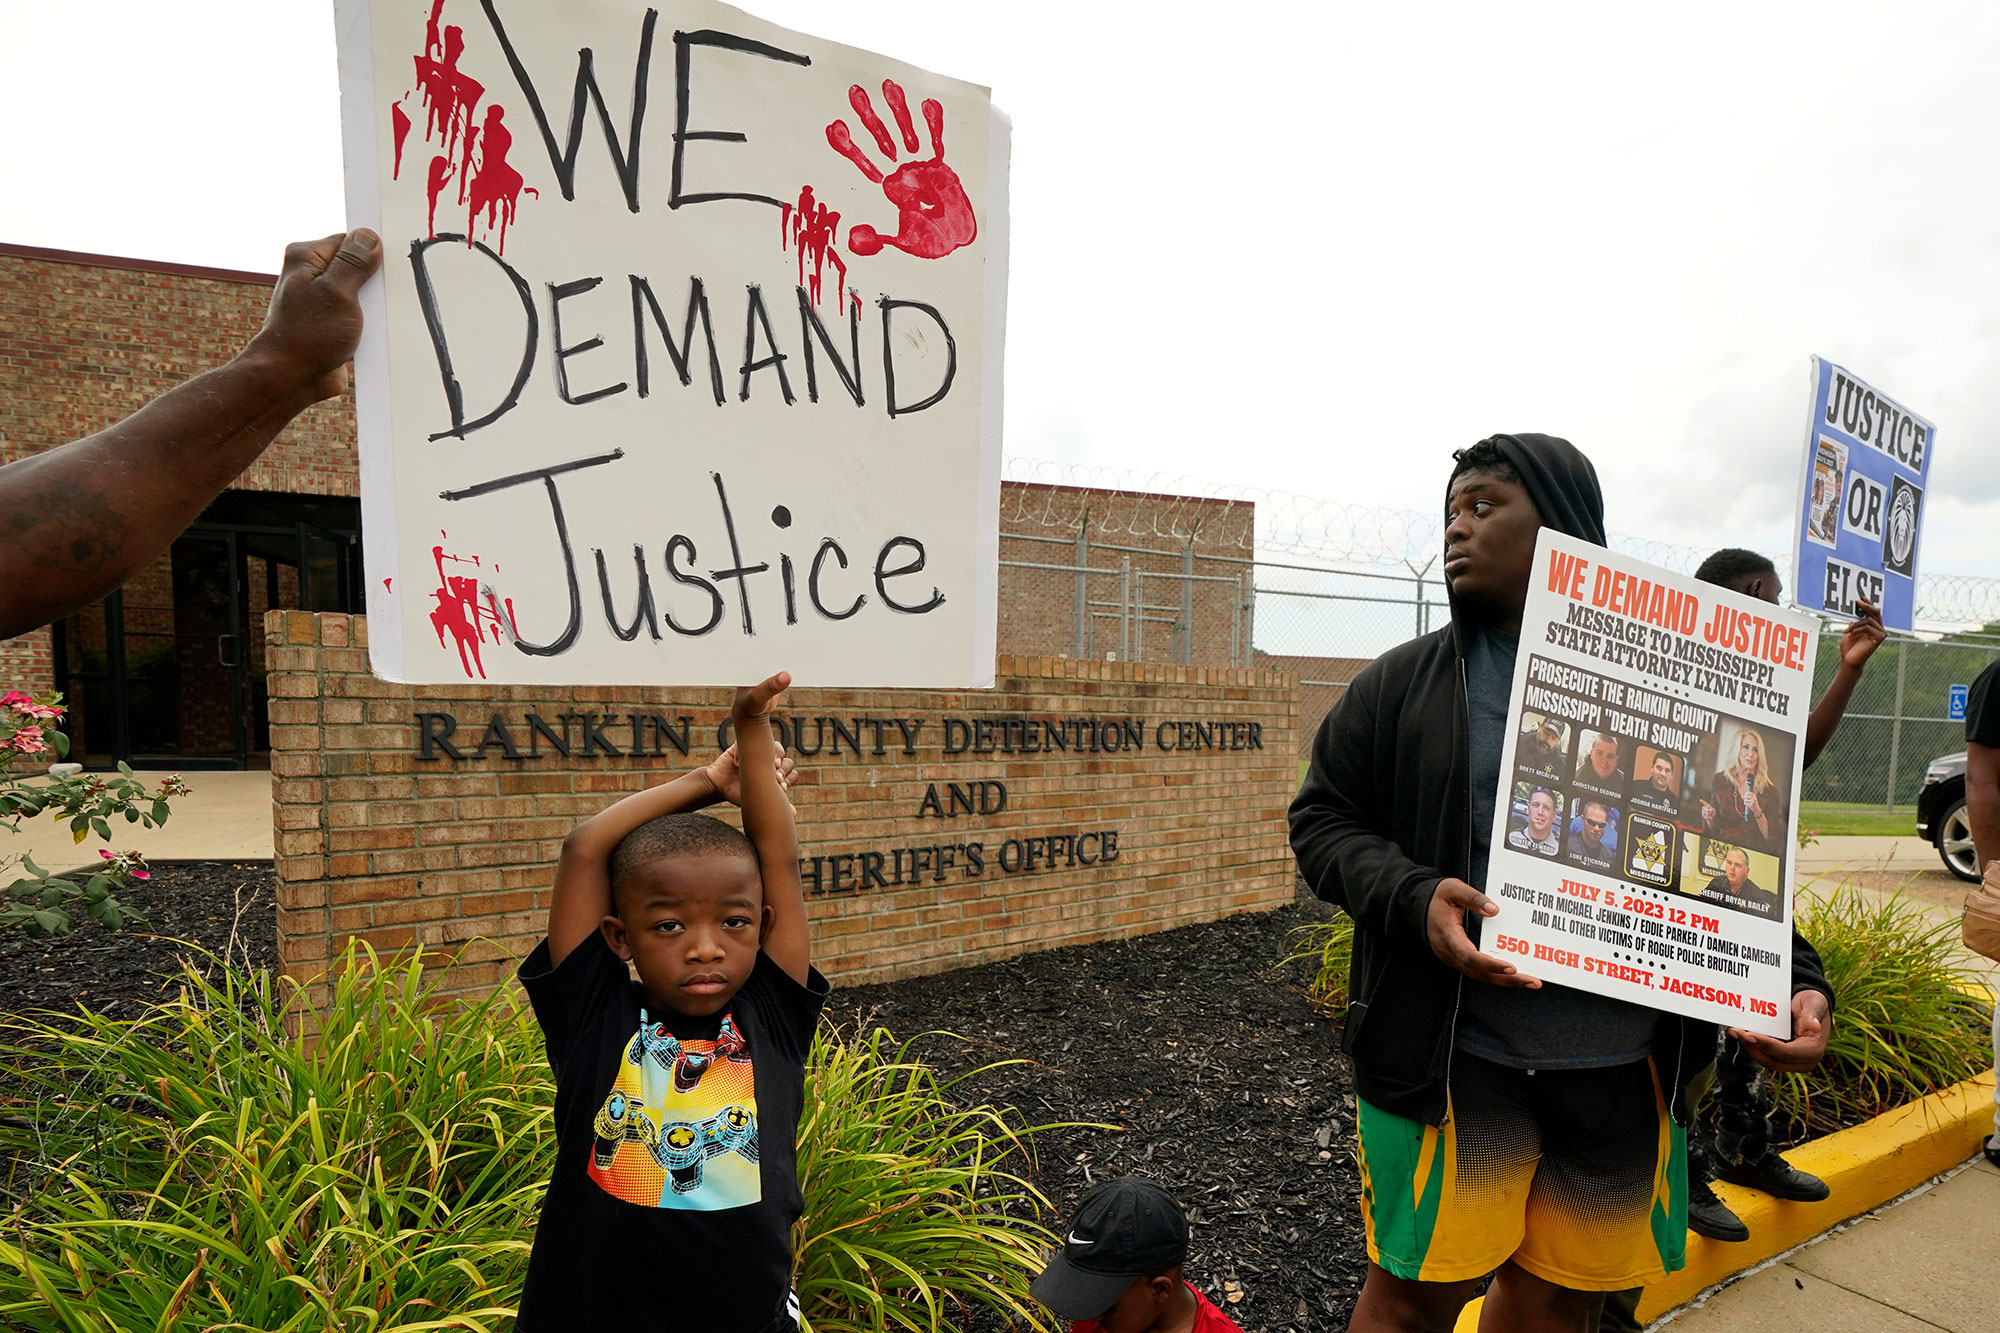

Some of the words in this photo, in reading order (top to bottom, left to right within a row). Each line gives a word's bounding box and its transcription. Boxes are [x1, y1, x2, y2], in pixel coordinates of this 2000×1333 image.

[479, 0, 811, 213] WE
[409, 232, 957, 442] DEMAND
[1826, 373, 1926, 473] JUSTICE
[1847, 478, 1881, 536] OR
[439, 446, 946, 656] Justice
[1548, 549, 1589, 601] WE
[1592, 565, 1699, 636] DEMAND
[1704, 604, 1808, 671] JUSTICE!
[1825, 563, 1883, 618] ELSE
[1546, 621, 1600, 658] STATE
[1602, 640, 1693, 685] ATTORNEY
[1694, 669, 1738, 700] LYNN
[1739, 682, 1790, 716] FITCH
[1566, 602, 1647, 647] MESSAGE
[1650, 633, 1672, 654] TO
[1674, 640, 1775, 687] MISSISSIPPI
[1525, 685, 1601, 727] MISSISSIPPI
[1604, 709, 1650, 743] "DEATH
[1651, 724, 1699, 753] SQUAD"
[1529, 657, 1600, 699] PROSECUTE
[1602, 679, 1623, 705] THE
[1626, 688, 1671, 719] RANKIN
[1672, 702, 1719, 734] COUNTY
[414, 713, 694, 760] RANKIN
[943, 718, 1145, 754] DETENTION
[1156, 721, 1264, 751] CENTER
[916, 780, 1007, 818] AND
[1634, 816, 1651, 826] RANKIN
[1652, 821, 1670, 831] COUNTY
[799, 841, 984, 896] HERIFF'S
[1000, 830, 1119, 872] OFFICE
[1630, 869, 1667, 883] MISSISSIPPI
[1501, 882, 1535, 904] JUSTICE
[1538, 892, 1553, 909] FOR
[1556, 896, 1593, 919] MICHAEL
[1596, 908, 1631, 930] JENKINS
[1640, 919, 1664, 938] EDDIE
[1666, 926, 1698, 946] PARKER
[1707, 936, 1739, 957] DAMIEN
[1741, 945, 1781, 968] CAMERON
[1558, 879, 1601, 901] JULY
[1622, 895, 1664, 919] 2023
[1668, 908, 1686, 925] 12
[1690, 913, 1719, 934] PM
[1698, 888, 1723, 901] SHERIFF
[1725, 895, 1746, 907] BRYAN
[1748, 901, 1770, 912] BAILEY
[1497, 934, 1529, 955] 550
[1534, 944, 1580, 968] HIGH
[1583, 957, 1655, 990] STREET,
[1659, 976, 1745, 1012] JACKSON,
[1750, 998, 1778, 1017] MS
[1531, 910, 1549, 927] AND
[1552, 915, 1566, 932] ALL
[1570, 920, 1596, 939] OTHER
[1598, 927, 1632, 949] VICTIMS
[1635, 936, 1646, 952] OF
[1648, 940, 1674, 960] ROGUE
[1677, 948, 1705, 967] POLICE
[1707, 955, 1750, 978] BRUTALITY
